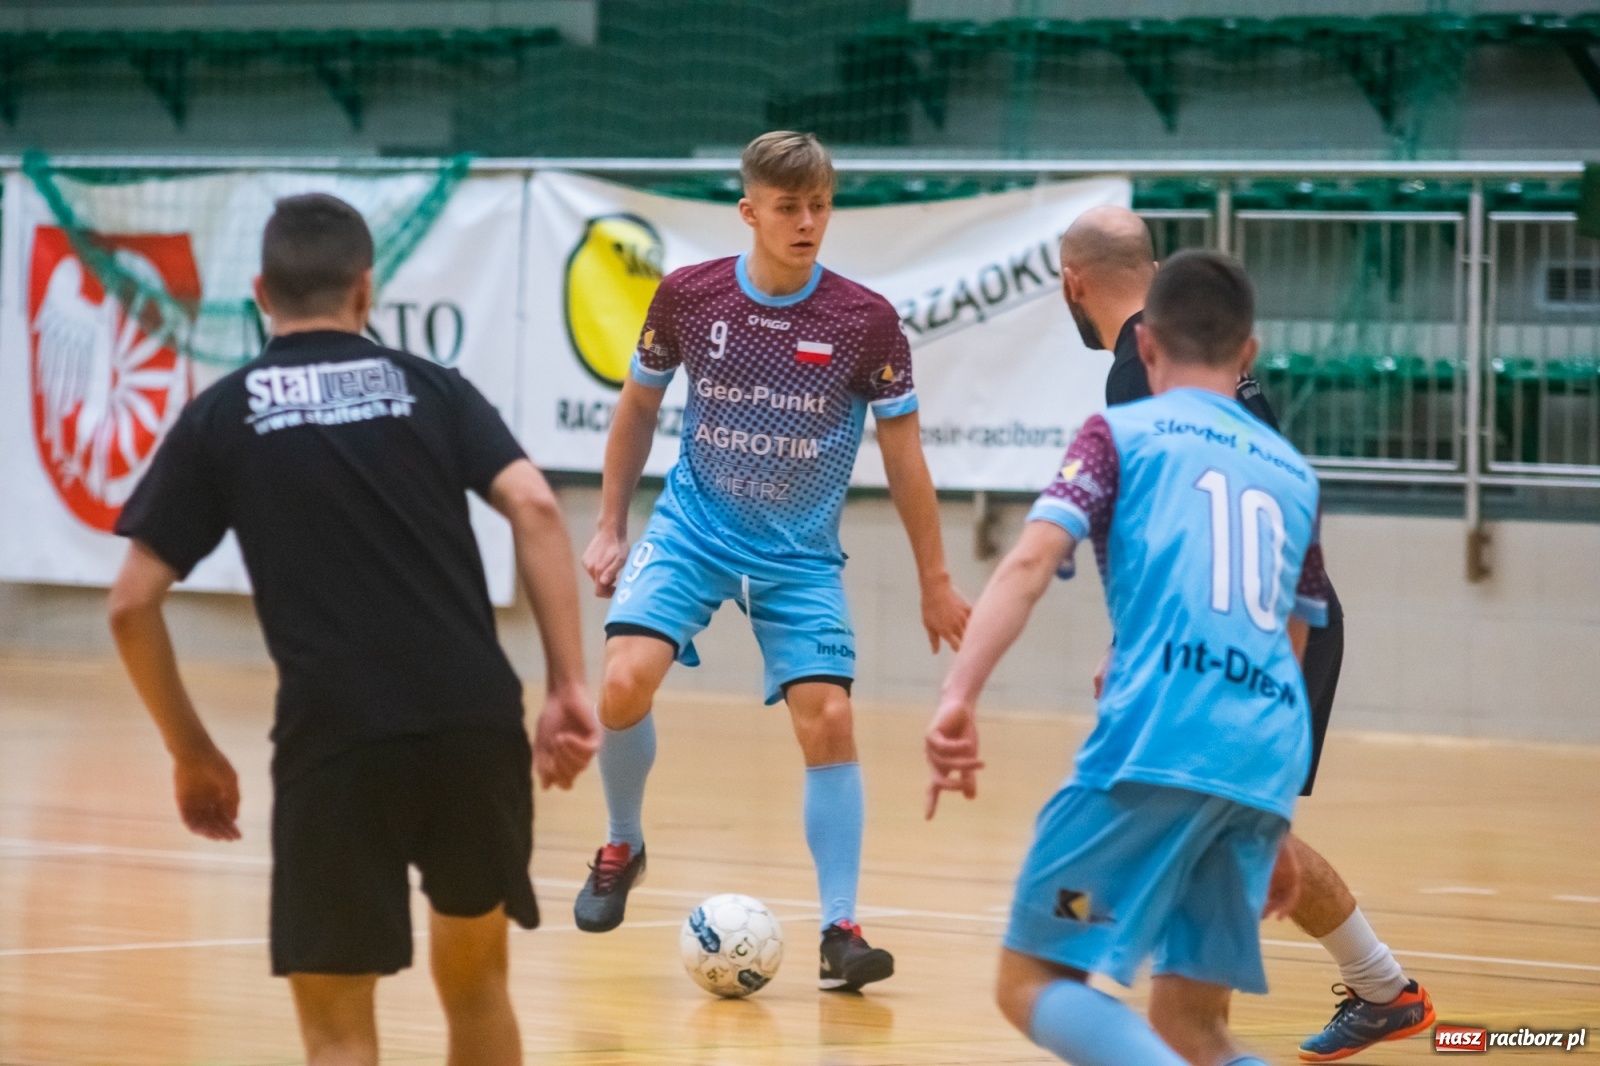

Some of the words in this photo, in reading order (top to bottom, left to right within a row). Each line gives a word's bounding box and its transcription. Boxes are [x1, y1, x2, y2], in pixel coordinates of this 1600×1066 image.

[708, 320, 729, 360] 9
[696, 377, 826, 414] Geo-Punkt
[695, 423, 818, 459] AGROTIM
[715, 474, 791, 501] KIETRZ
[624, 541, 654, 583] 9
[1193, 467, 1285, 634] 10
